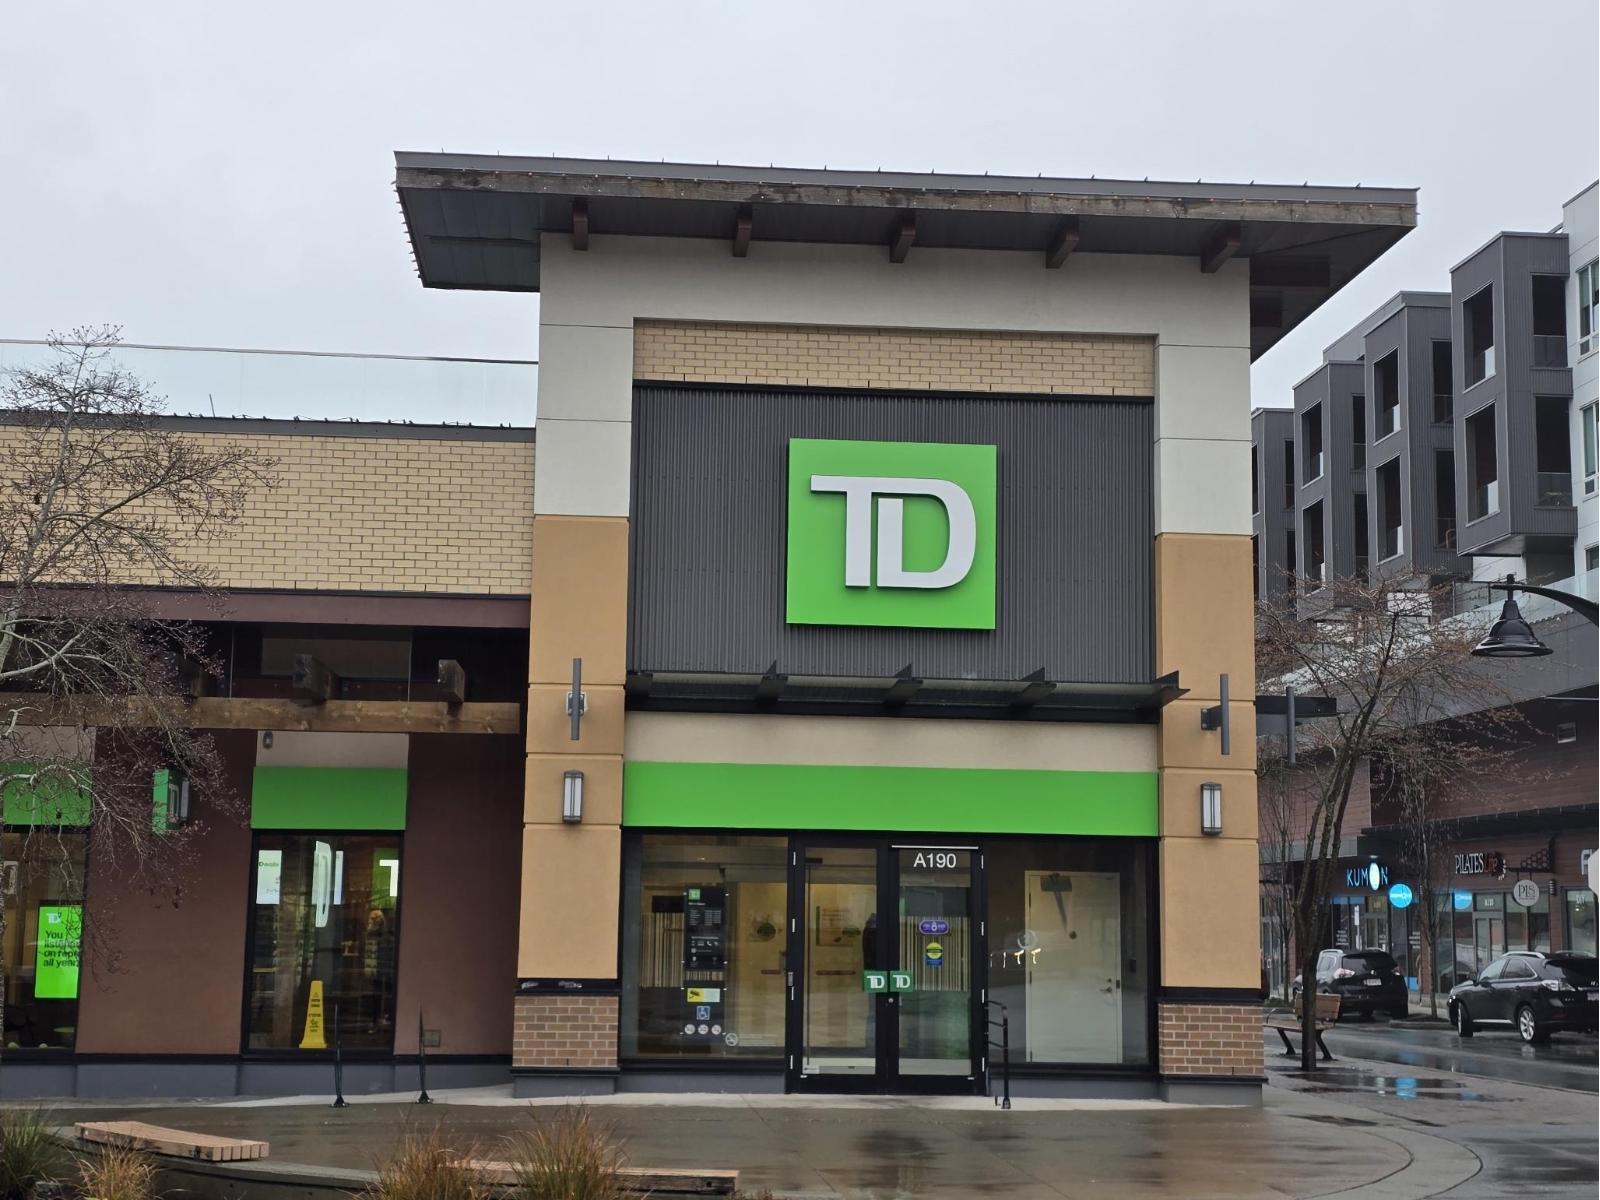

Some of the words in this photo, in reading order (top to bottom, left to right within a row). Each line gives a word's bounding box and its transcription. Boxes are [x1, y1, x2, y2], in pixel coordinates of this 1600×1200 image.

[811, 475, 977, 588] TD
[913, 852, 957, 869] A190
[1455, 852, 1484, 874] PILATES
[1346, 862, 1388, 891] KUMON
[45, 930, 63, 940] You
[43, 959, 54, 967] all
[867, 975, 885, 989] TD
[893, 974, 911, 988] TD
